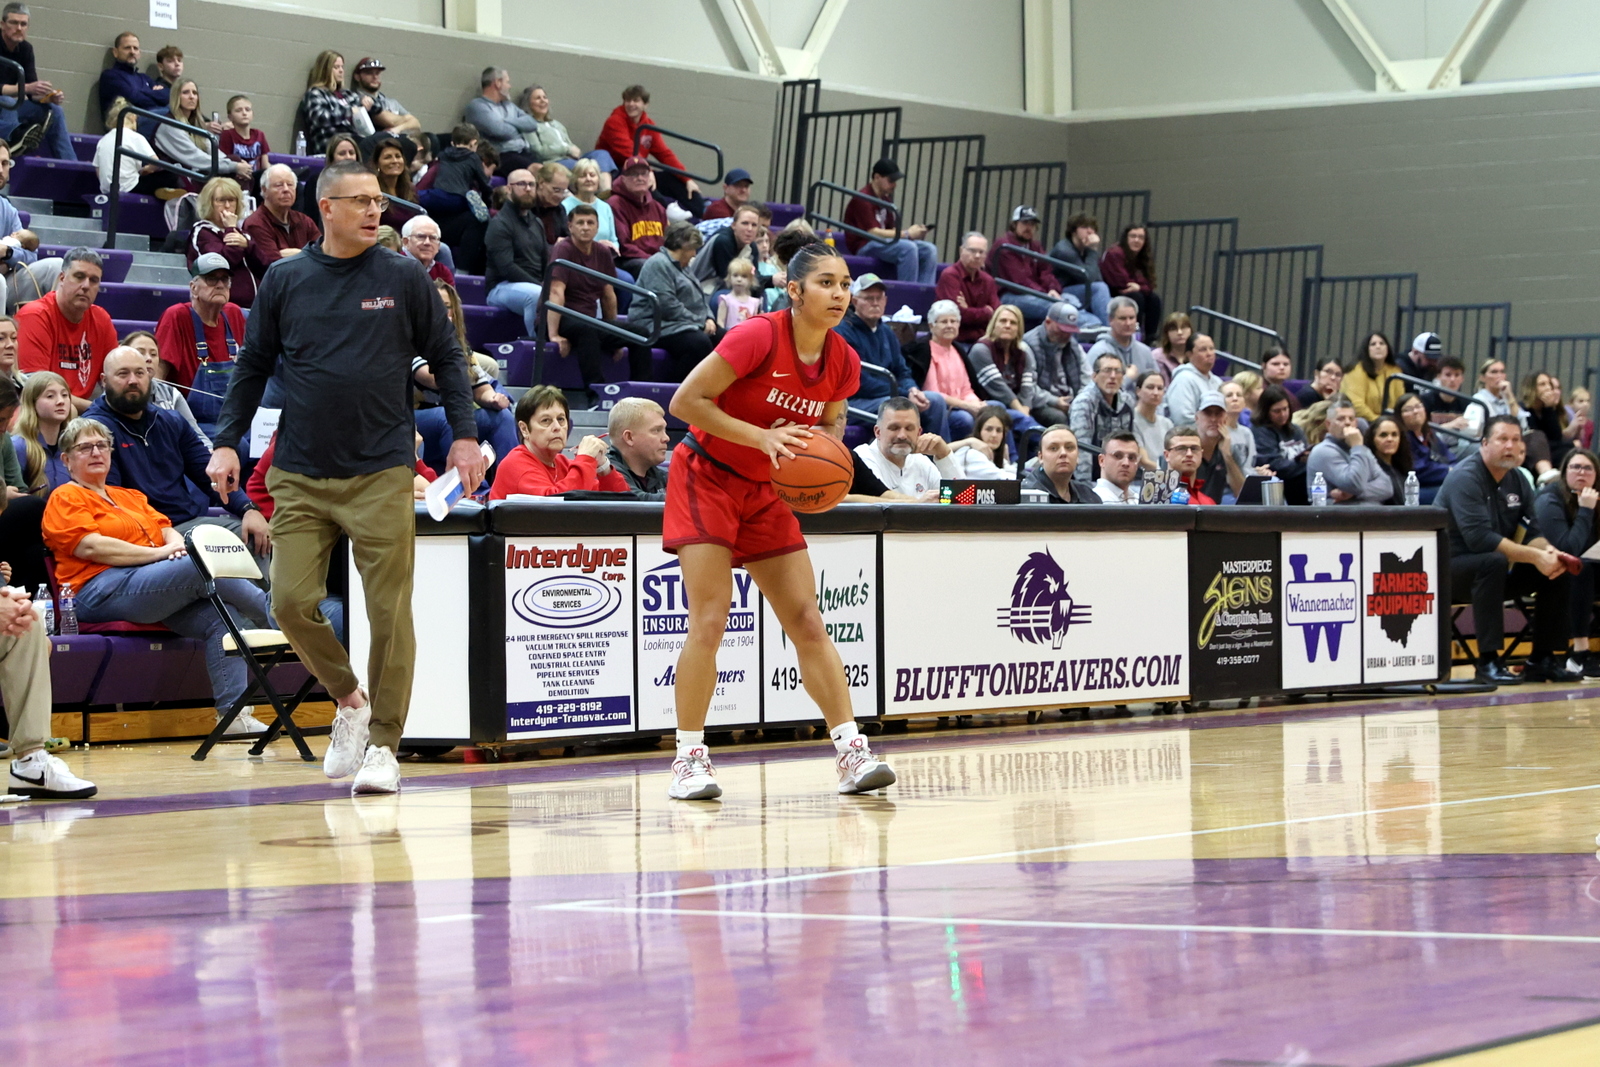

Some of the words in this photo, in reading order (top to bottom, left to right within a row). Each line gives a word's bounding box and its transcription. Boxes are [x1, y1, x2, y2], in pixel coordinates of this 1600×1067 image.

[778, 489, 826, 505] Rawlings
[204, 545, 245, 553] BLUFFTON
[505, 543, 628, 573] Interdyne
[1222, 560, 1272, 574] MASTERPIECE
[602, 571, 626, 582] Corp.
[1373, 571, 1428, 594] FARMERS
[542, 588, 592, 597] ENVIRONMENTAL
[553, 600, 582, 609] SERVICES
[1289, 593, 1354, 613] Wannemacher
[1367, 593, 1434, 616] EQUIPMENT
[1197, 571, 1273, 650] SIGNS
[516, 634, 535, 642] HOUR
[537, 633, 575, 641] EMERGENCY
[826, 623, 864, 643] PIZZA
[526, 643, 554, 651] VACUUM
[555, 642, 577, 650] TRUCK
[578, 641, 610, 649] SERVICES
[643, 639, 674, 653] Looking
[737, 636, 754, 647] 1904
[528, 652, 561, 660] CONFINED
[563, 651, 583, 659] SPACE
[585, 650, 606, 658] ENTRY
[1216, 655, 1260, 665] 419-358-0077
[1367, 657, 1387, 668] URBANA
[1392, 655, 1416, 667] LAKEVIEW
[1421, 655, 1435, 665] ELIDA
[530, 661, 571, 669] INDUSTRIAL
[572, 660, 605, 668] CLEANING
[568, 669, 600, 677] SERVICES
[893, 654, 1182, 702] BLUFFTONBEAVERS.COM
[542, 680, 560, 688] TANK
[562, 678, 595, 686] CLEANING
[548, 688, 589, 697] DEMOLITION
[536, 701, 602, 714] 419-229-8192
[510, 711, 627, 727] Interdyne-Transvac.com
